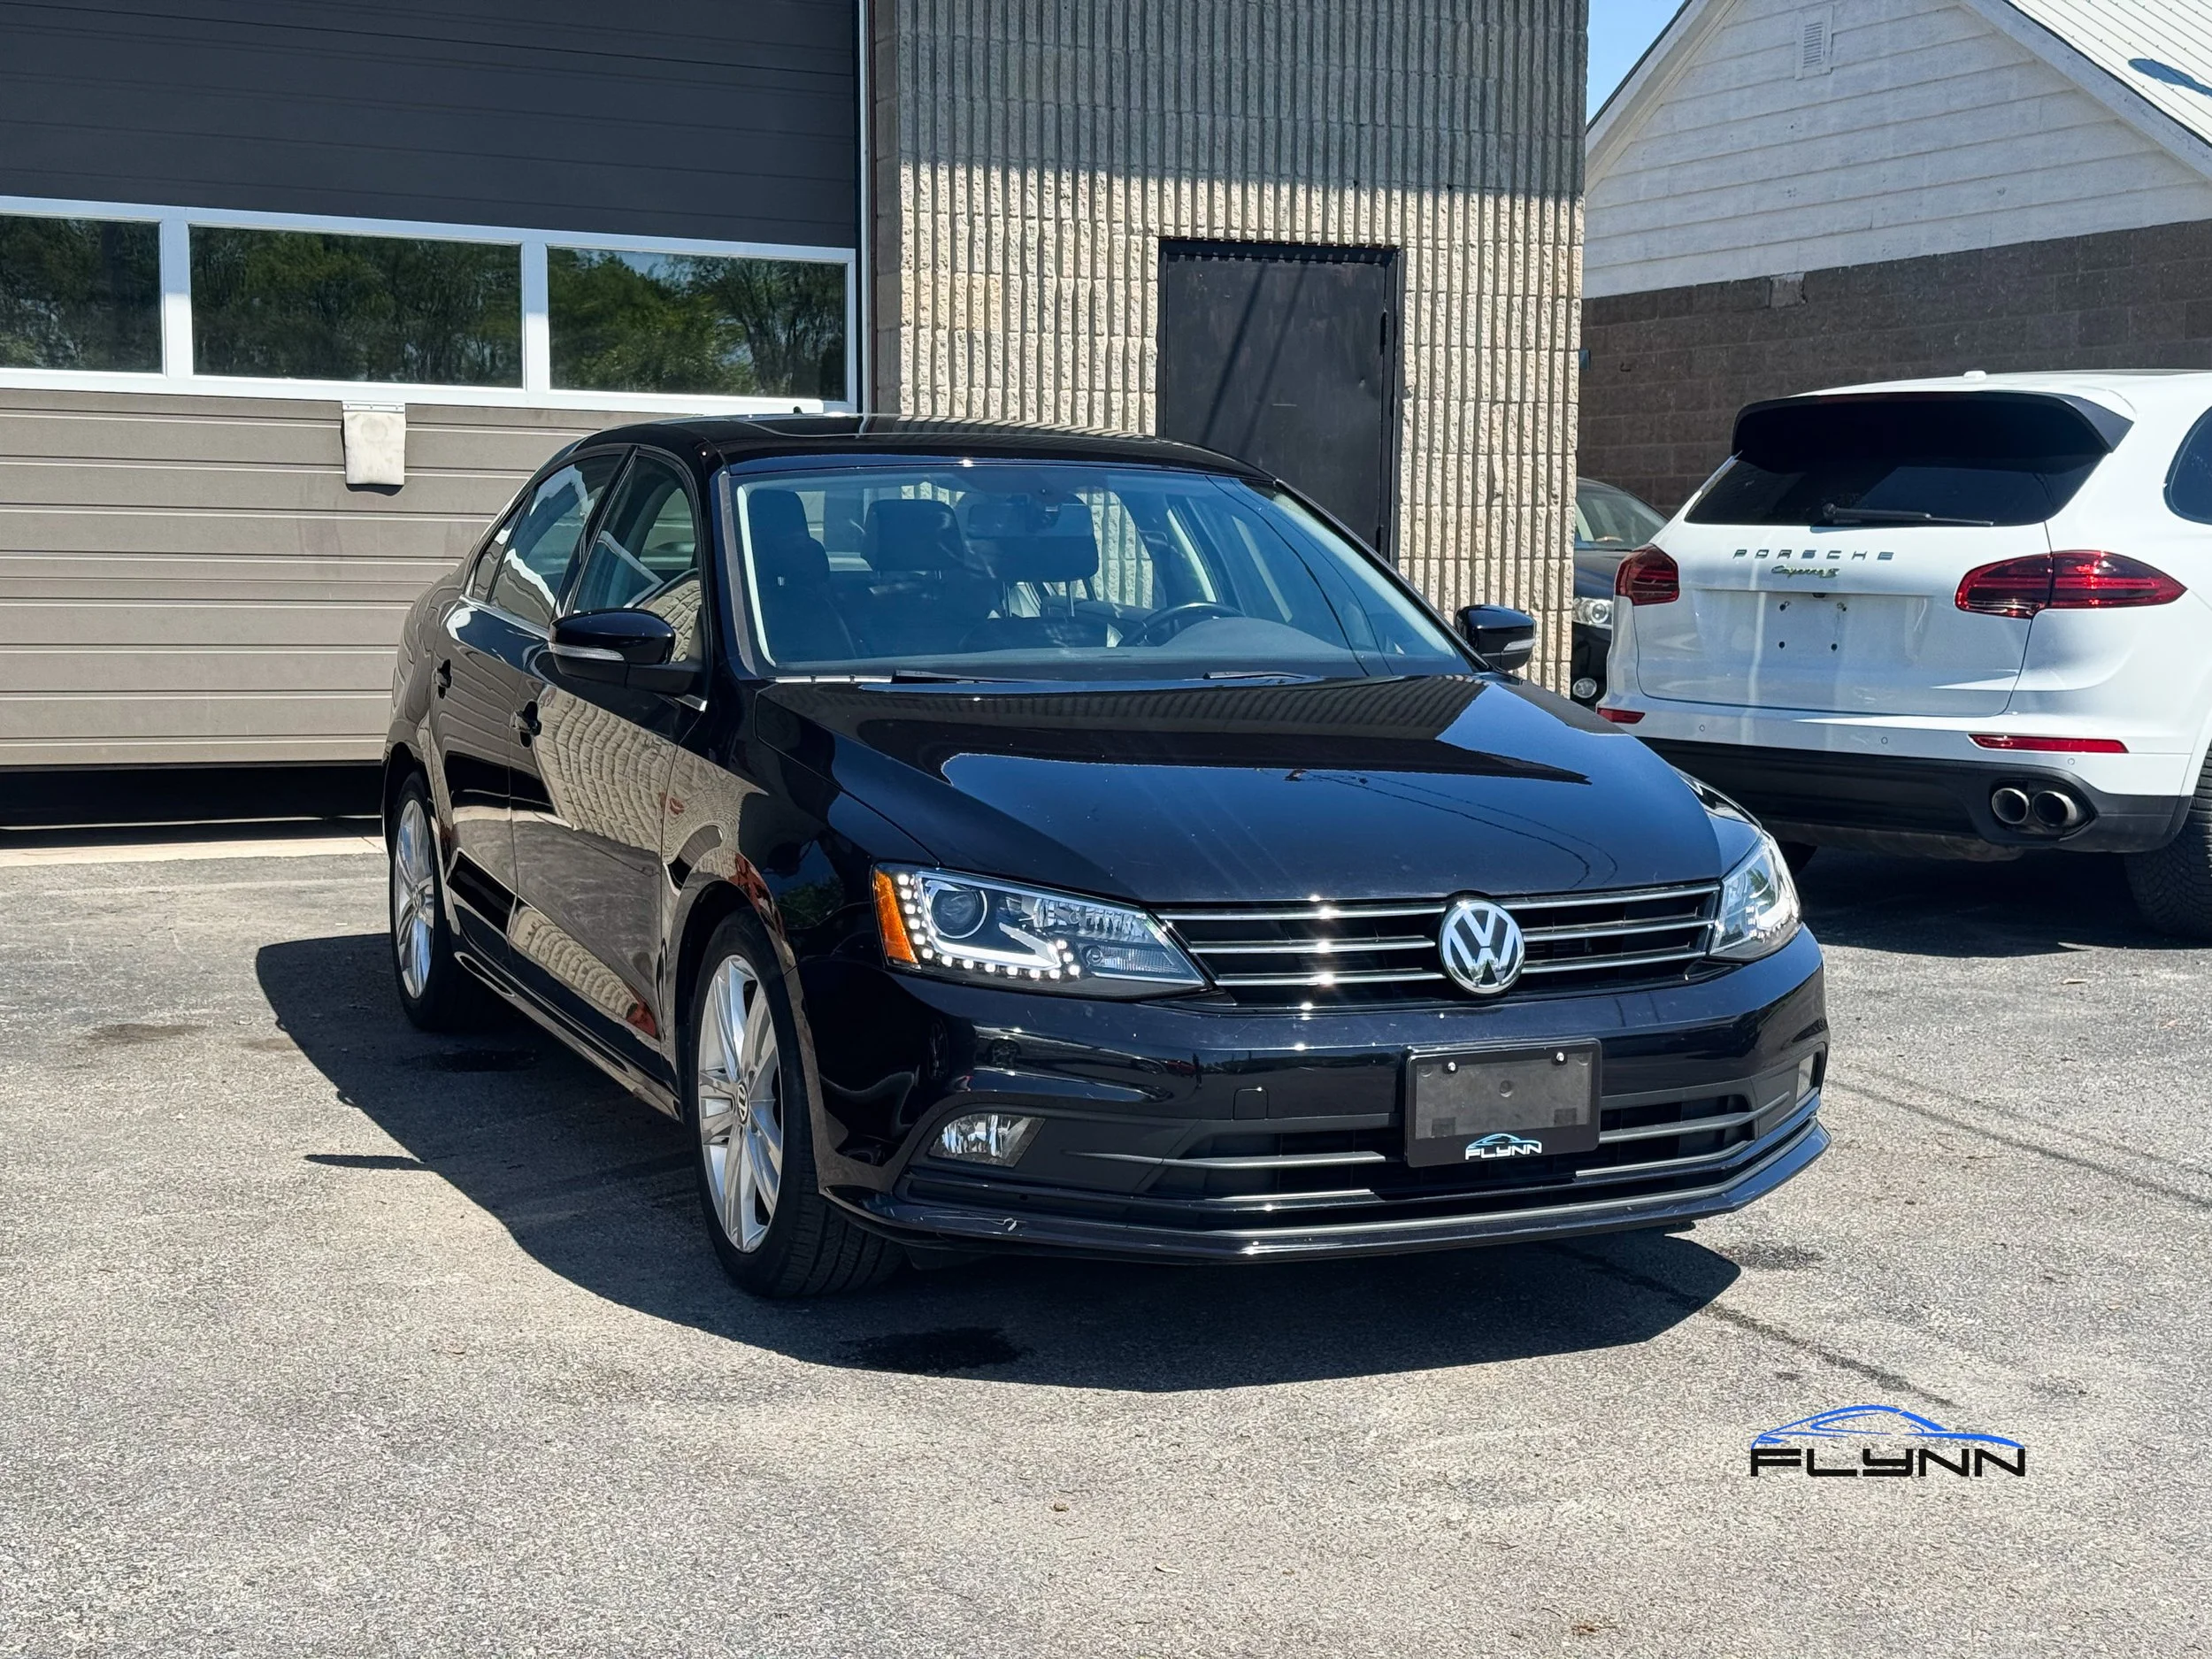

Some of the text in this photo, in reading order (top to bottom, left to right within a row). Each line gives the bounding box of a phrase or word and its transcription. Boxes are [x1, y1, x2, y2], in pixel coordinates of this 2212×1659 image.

[1732, 549, 1894, 560] PORSCHE
[1445, 902, 1522, 992] VW
[1465, 1142, 1542, 1160] FLYNN
